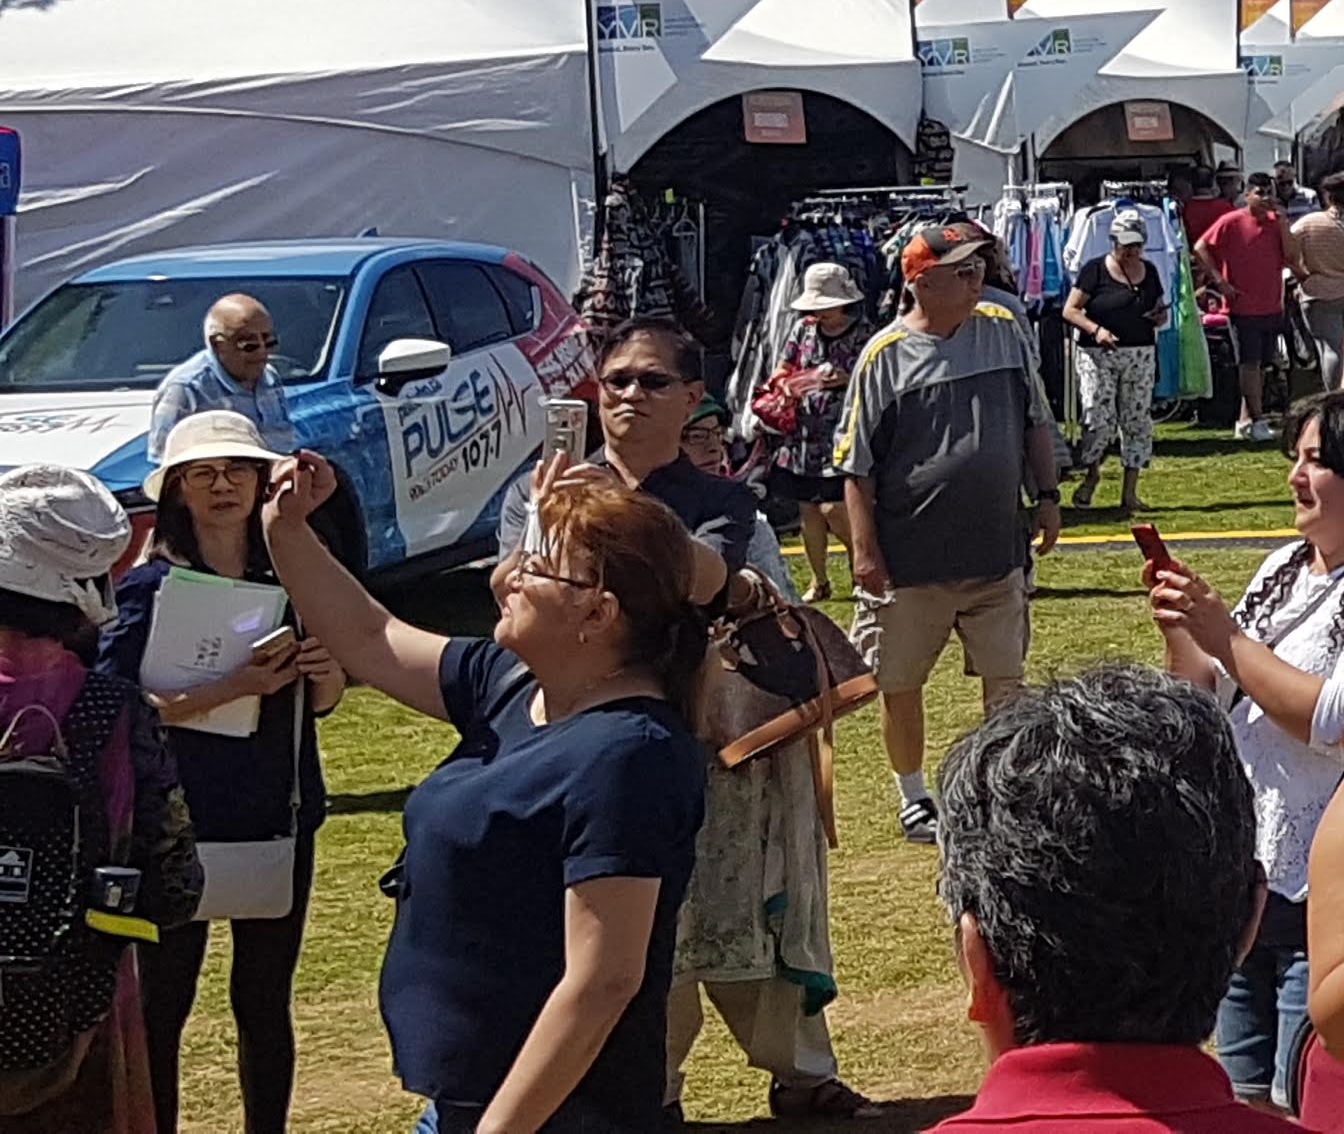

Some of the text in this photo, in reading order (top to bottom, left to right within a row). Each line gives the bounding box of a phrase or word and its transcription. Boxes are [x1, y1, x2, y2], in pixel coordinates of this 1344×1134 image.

[597, 17, 661, 40] YVR
[402, 369, 495, 479] PULSE
[462, 418, 502, 474] 107.7
